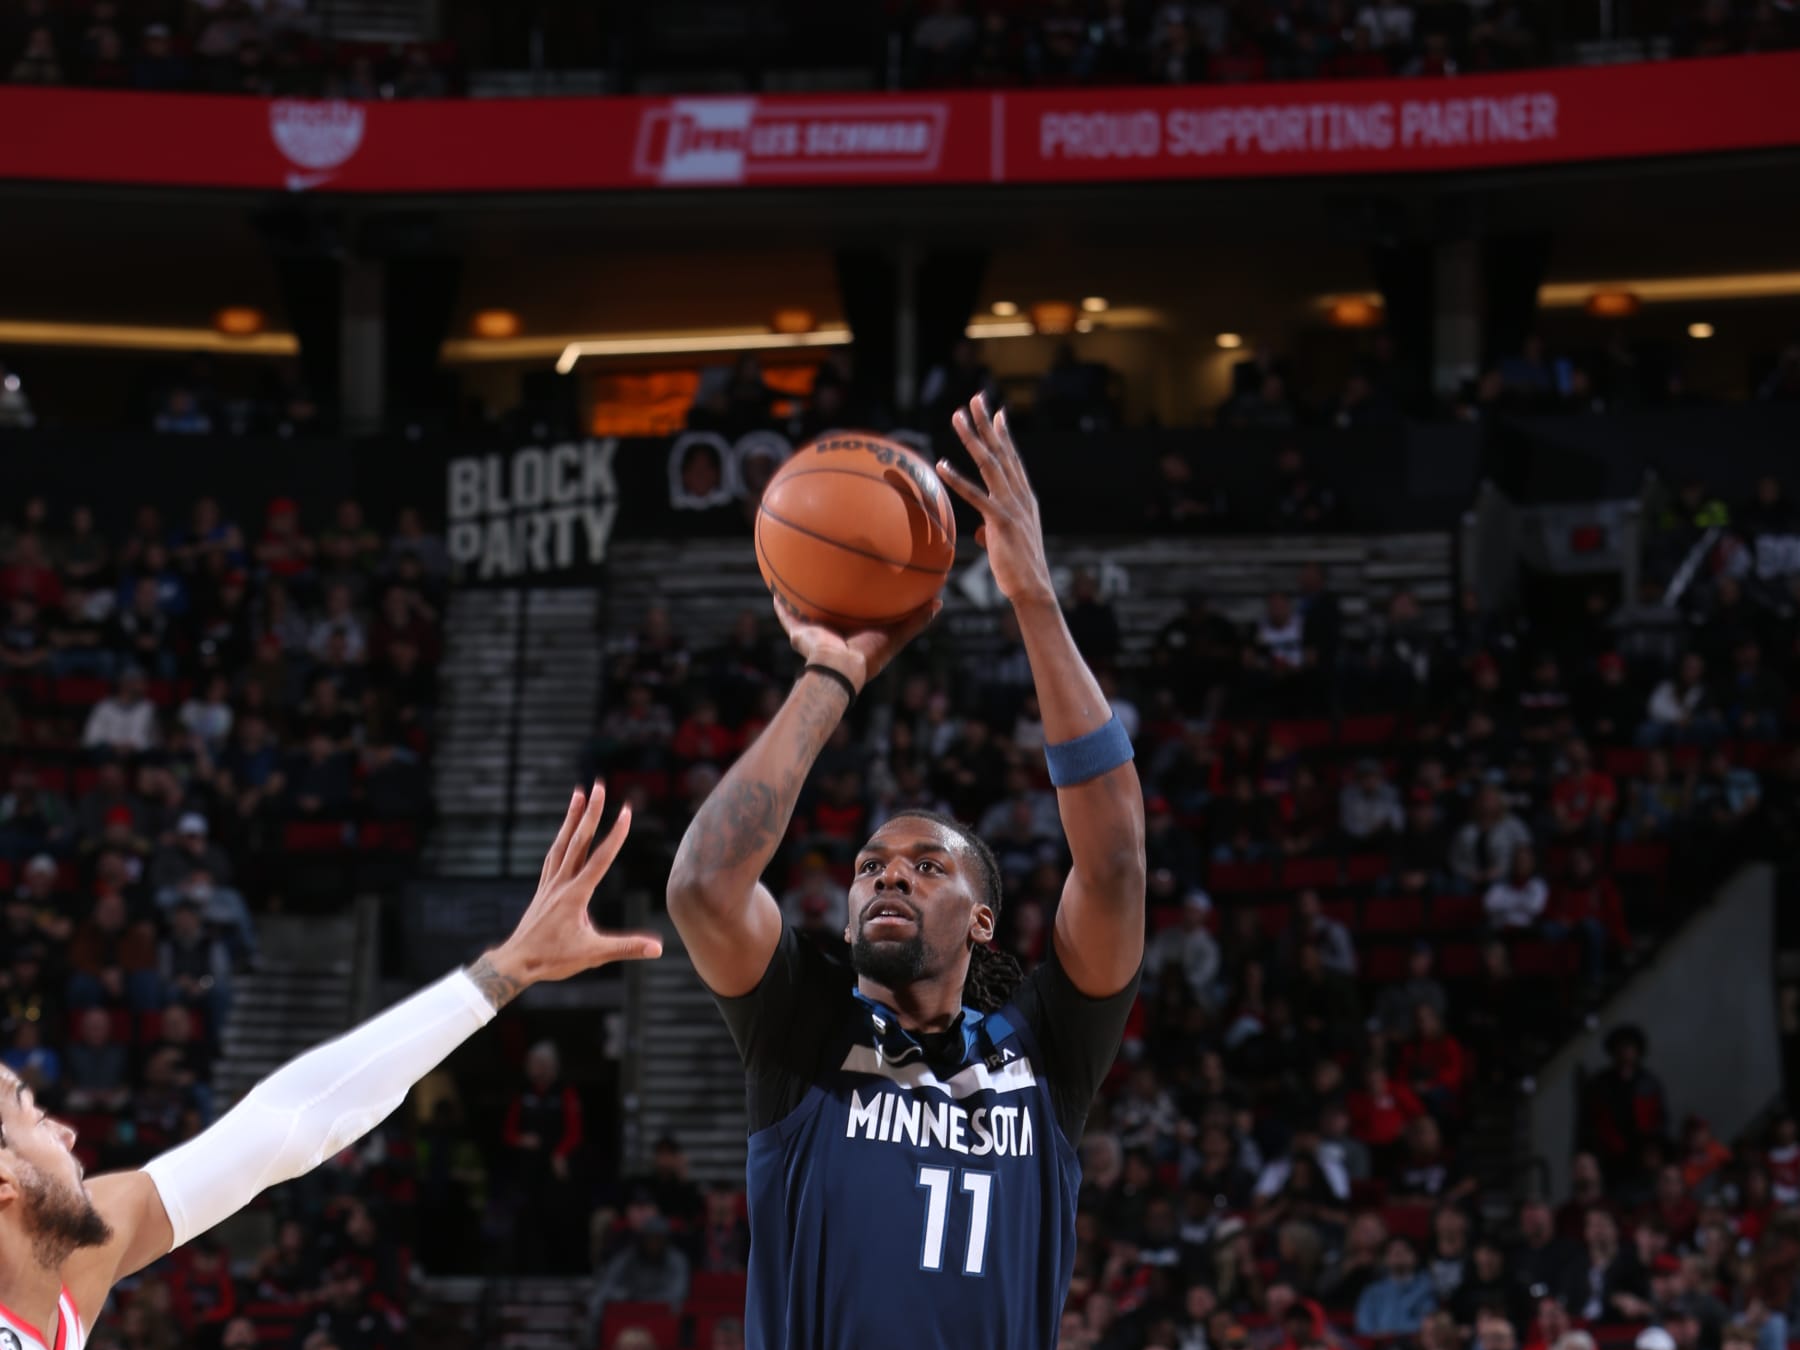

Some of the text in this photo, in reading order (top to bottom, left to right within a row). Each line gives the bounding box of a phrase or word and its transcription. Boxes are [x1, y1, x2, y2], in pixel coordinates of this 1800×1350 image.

[1041, 92, 1558, 159] PROUD SUPPORTING PARTNER
[449, 437, 619, 518] BLOCK
[449, 502, 619, 580] PARTY
[846, 1089, 1034, 1157] MINNESOTA
[915, 1163, 996, 1277] 11
